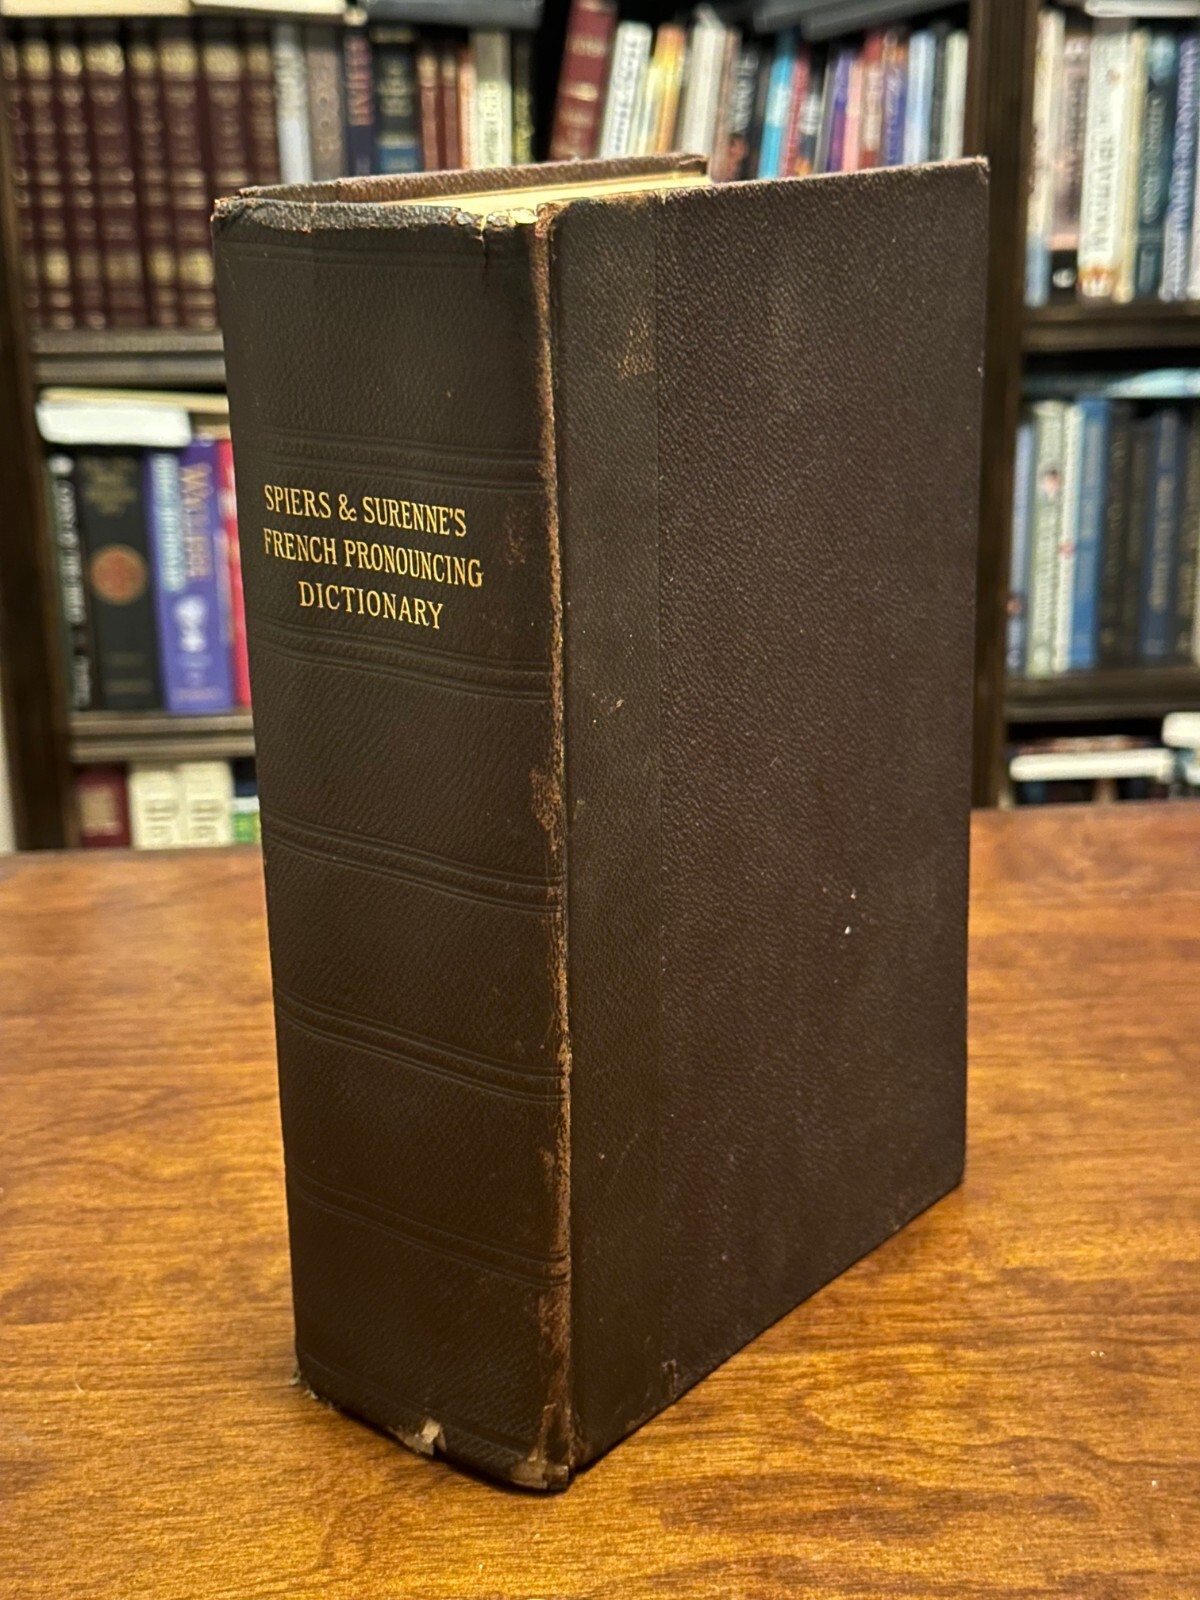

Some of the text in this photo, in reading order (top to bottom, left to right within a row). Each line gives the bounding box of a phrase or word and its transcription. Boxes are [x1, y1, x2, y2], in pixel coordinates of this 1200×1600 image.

[264, 484, 467, 538] SPIERS & SURENNE'S
[263, 527, 483, 587] FRENCH PRONOUNCING
[298, 581, 443, 630] DICTIONARY
